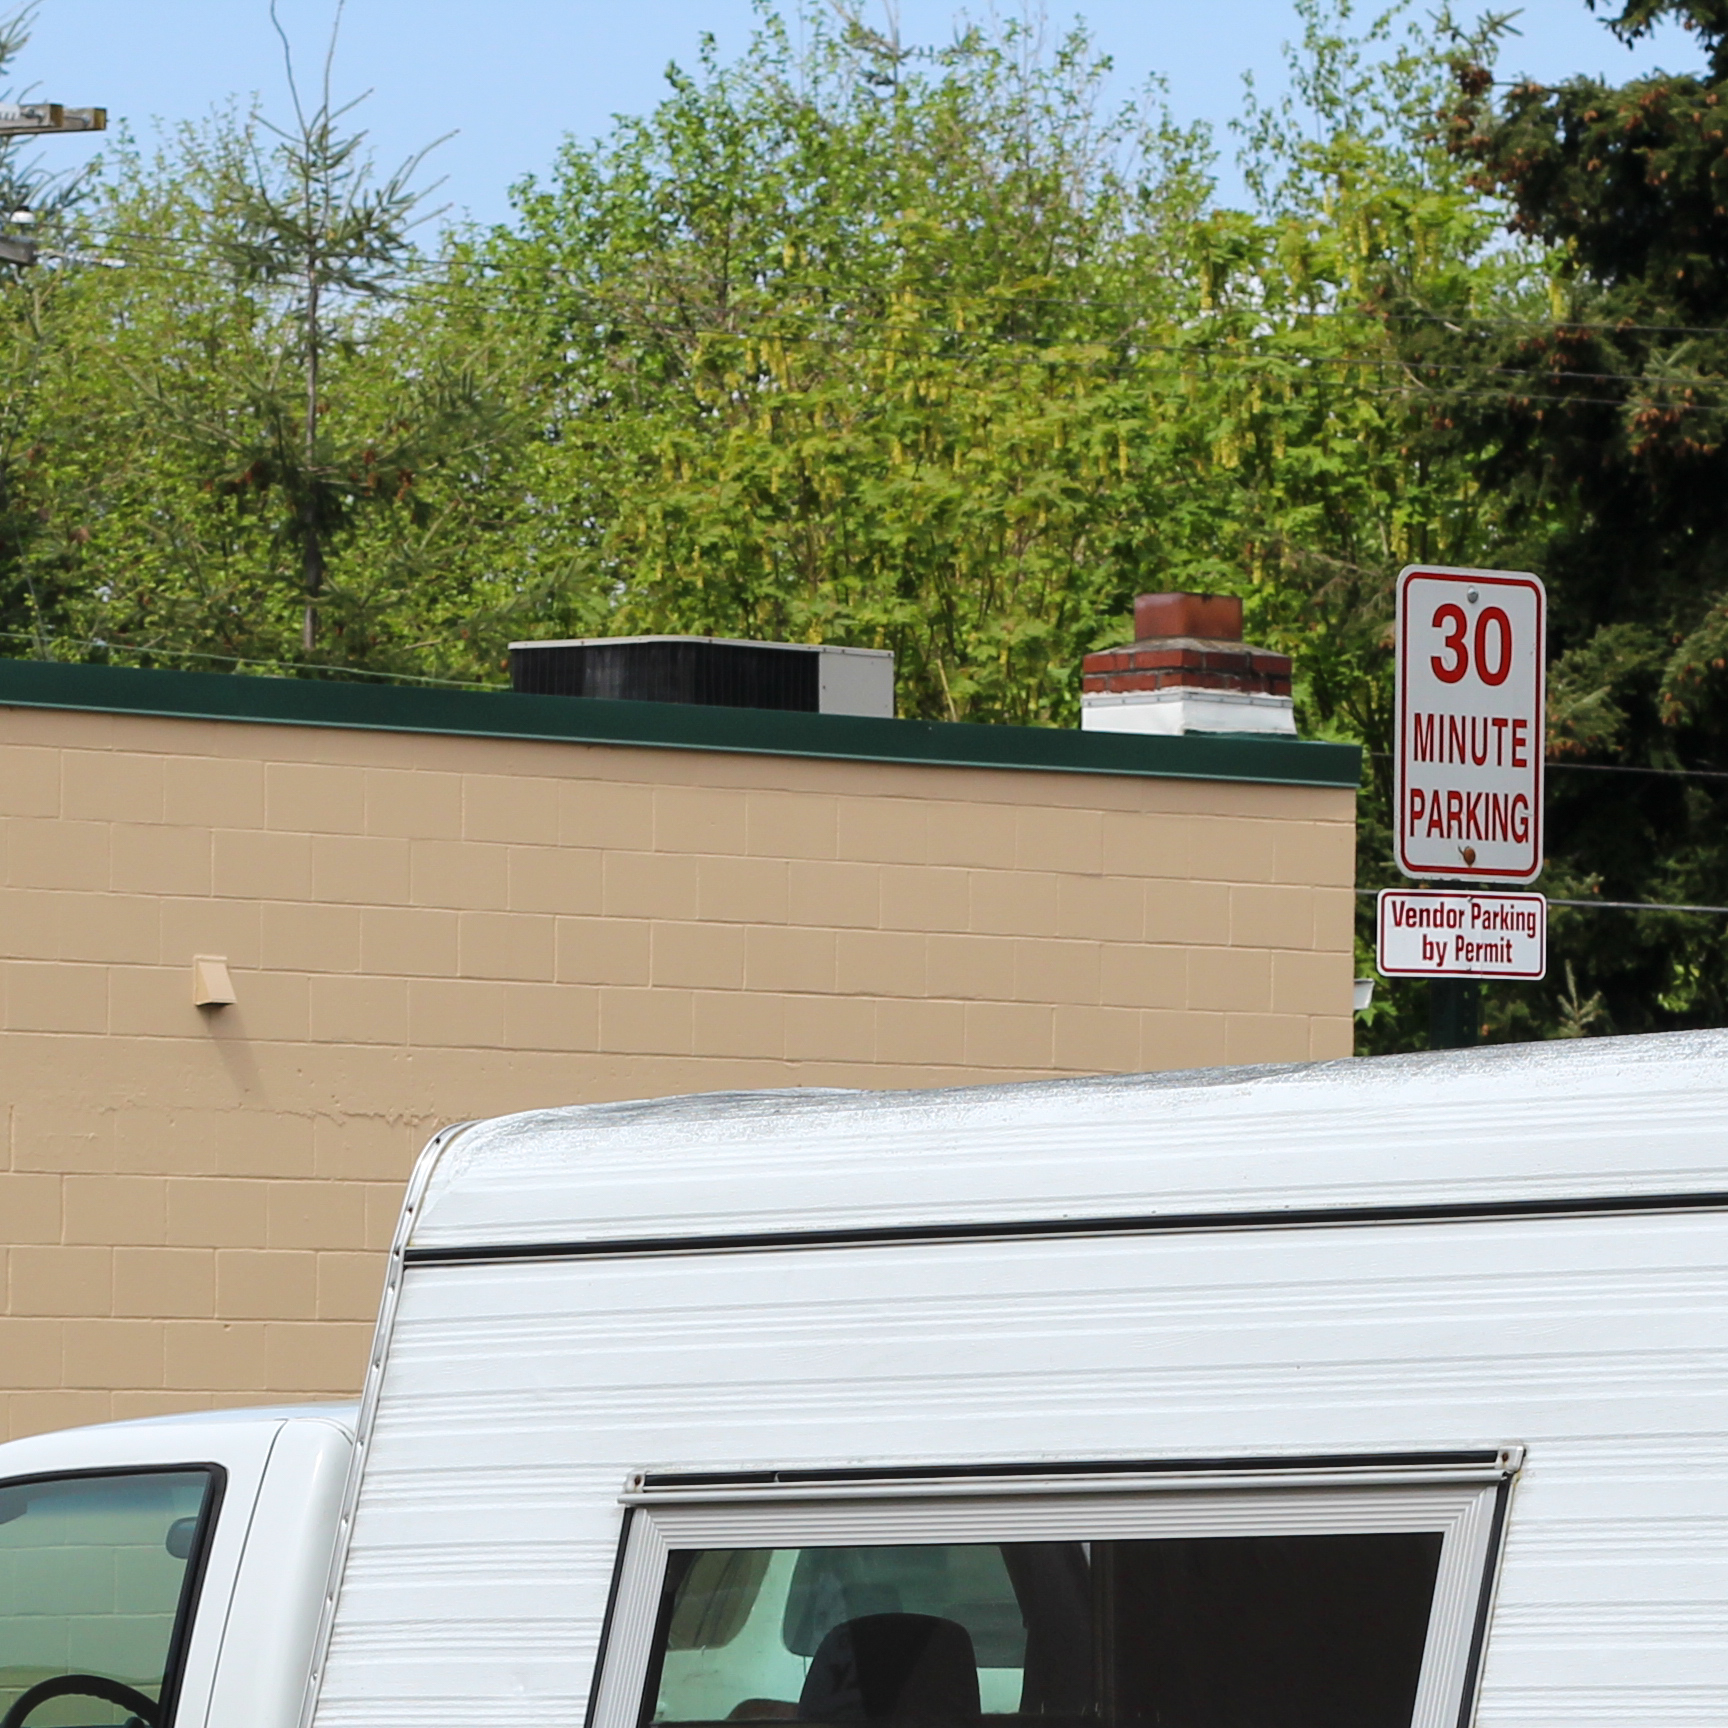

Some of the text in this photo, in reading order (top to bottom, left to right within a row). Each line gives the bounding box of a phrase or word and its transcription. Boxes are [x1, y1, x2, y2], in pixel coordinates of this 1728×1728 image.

[1430, 603, 1512, 686] 30
[1413, 713, 1528, 768] MINUTE
[1409, 788, 1529, 844] PARKING
[1391, 900, 1536, 939] Vendor Parking
[1422, 934, 1513, 967] by Permit
